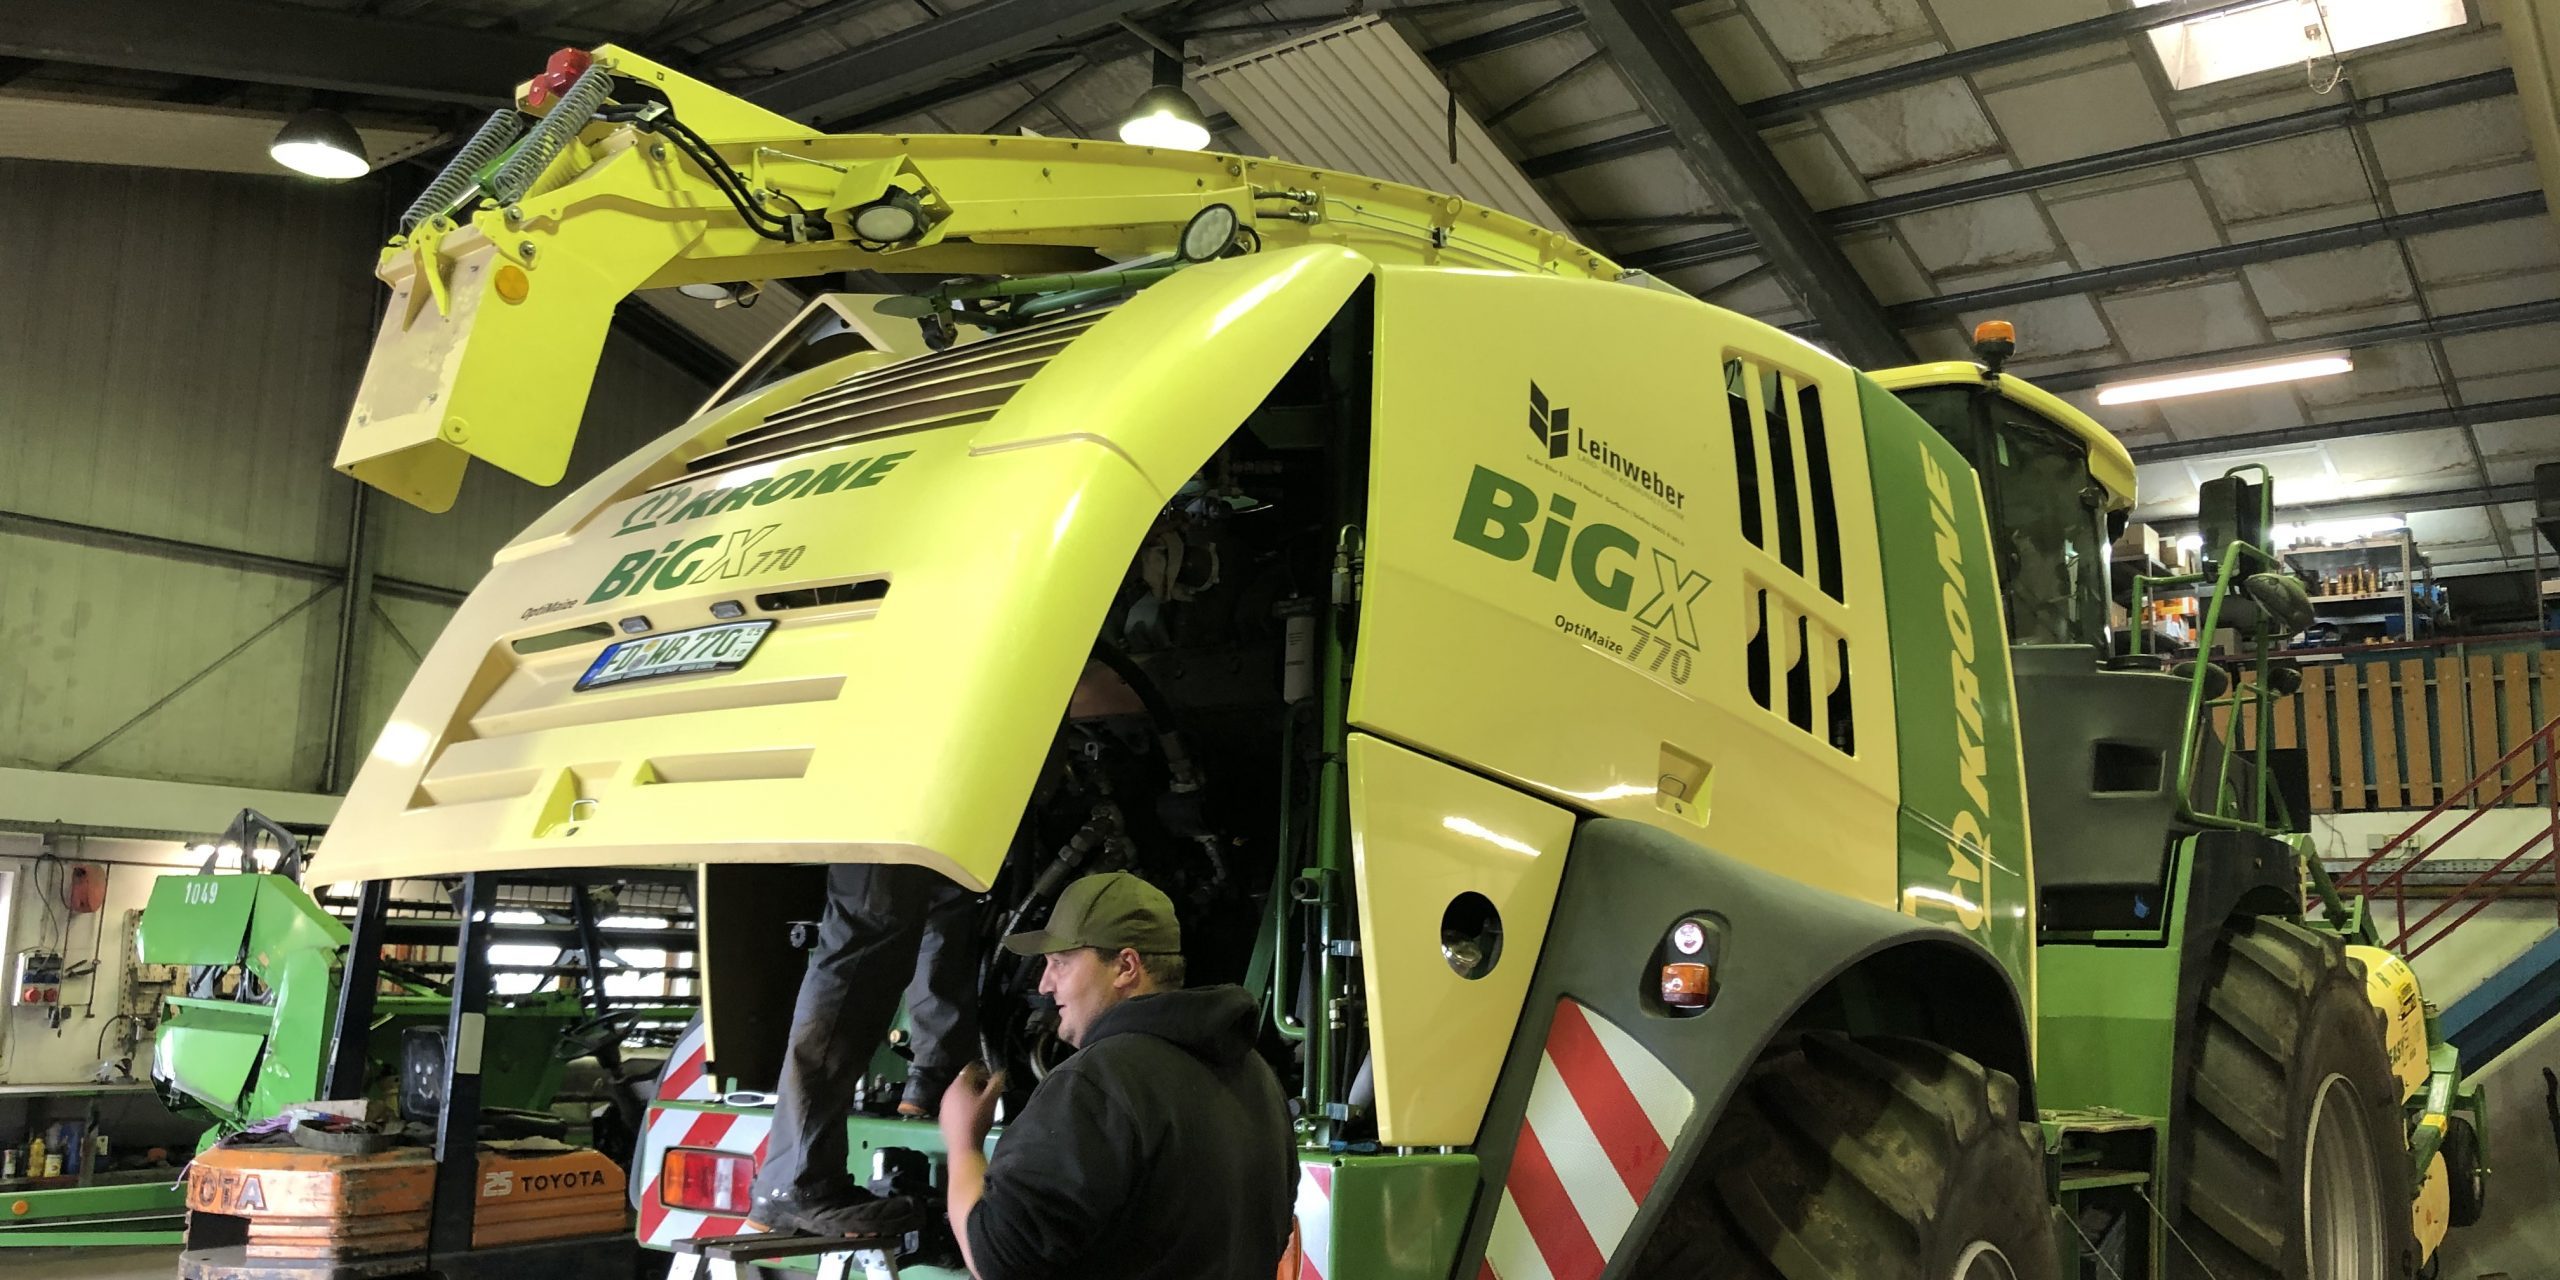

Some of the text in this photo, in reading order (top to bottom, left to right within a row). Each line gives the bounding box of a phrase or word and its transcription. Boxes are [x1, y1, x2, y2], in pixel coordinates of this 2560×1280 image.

[664, 450, 916, 525] KRONE
[1577, 427, 1685, 509] Leinweber
[744, 545, 807, 576] 770
[679, 628, 744, 661] 770
[1554, 614, 1692, 686] OptiMaize 770
[1919, 440, 1990, 818] KRONE
[185, 882, 219, 904] 1049
[483, 1170, 606, 1197] 25 TOYOTA
